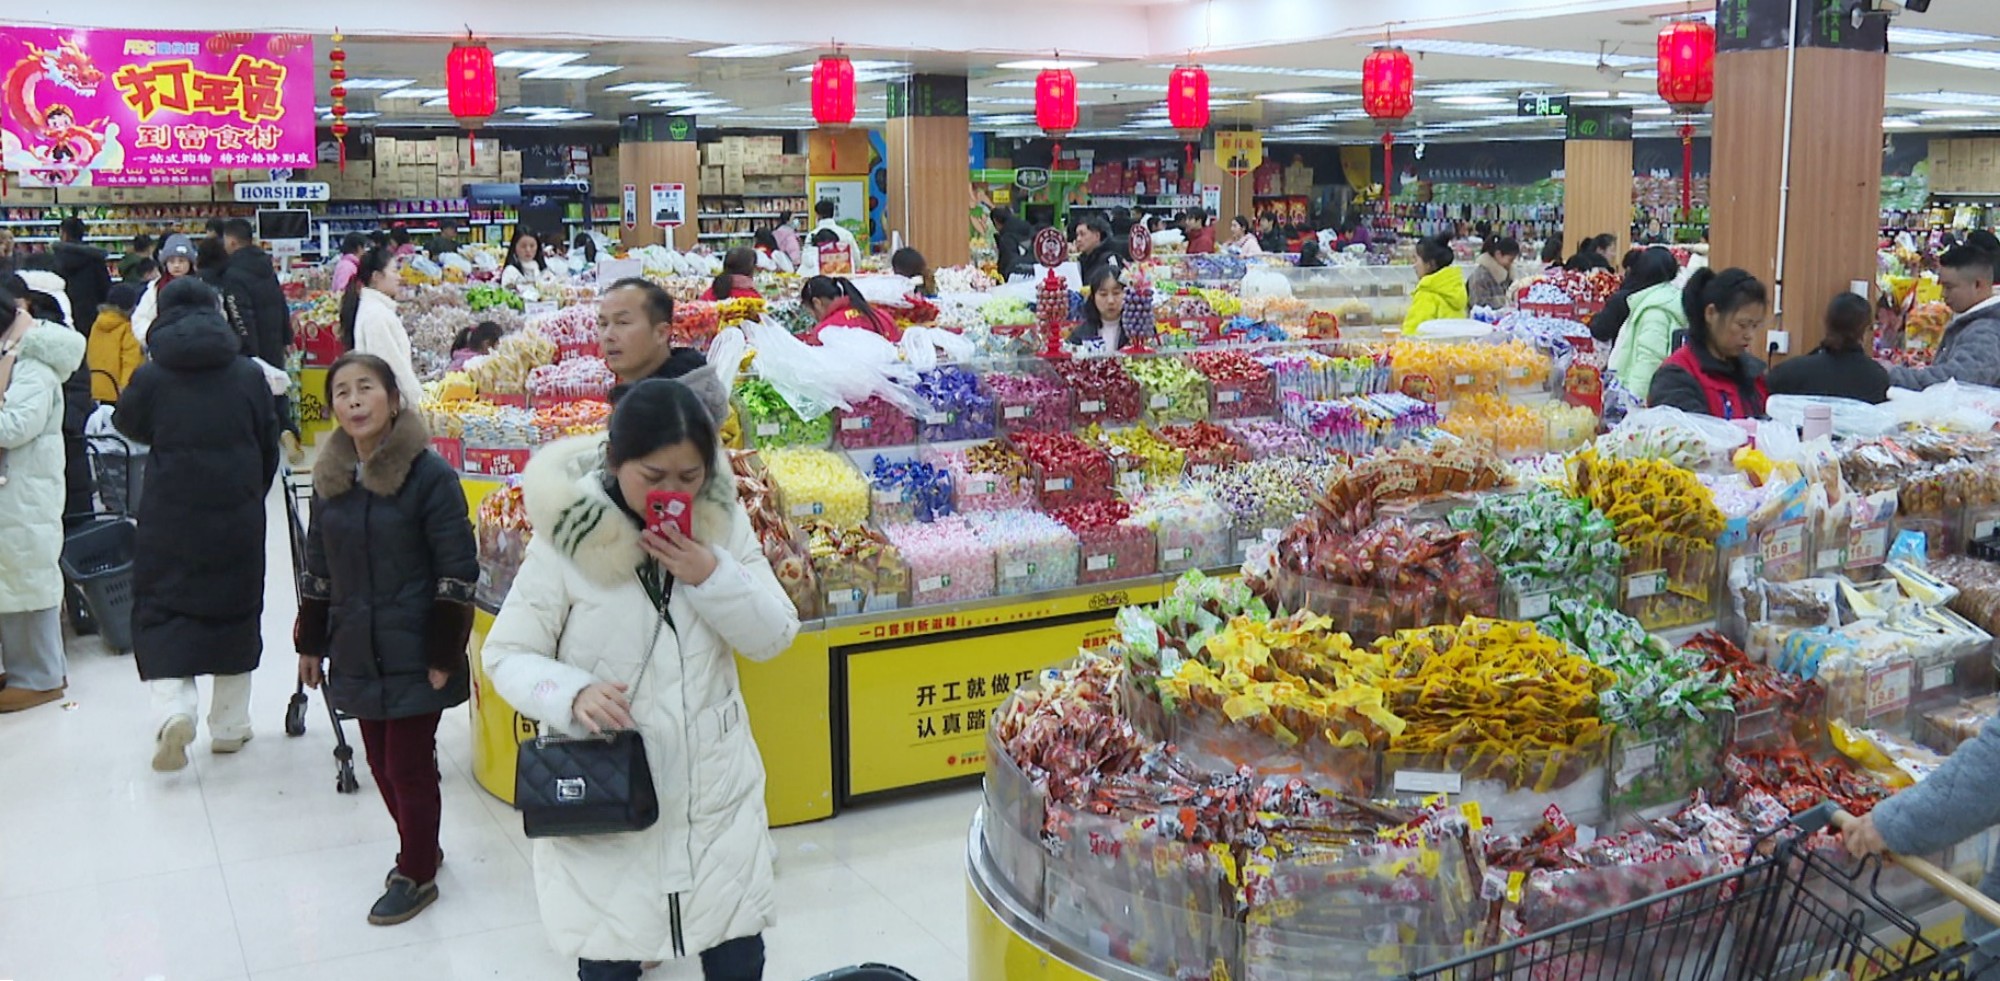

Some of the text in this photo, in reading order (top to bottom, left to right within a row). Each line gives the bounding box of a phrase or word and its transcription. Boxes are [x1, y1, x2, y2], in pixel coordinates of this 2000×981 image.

[113, 55, 286, 122] 打年货
[135, 124, 283, 150] 到富食村
[133, 152, 213, 165] 一站式购物
[241, 187, 294, 199] HORSH
[1764, 541, 1789, 560] 19.8
[917, 707, 999, 738] 认真踏
